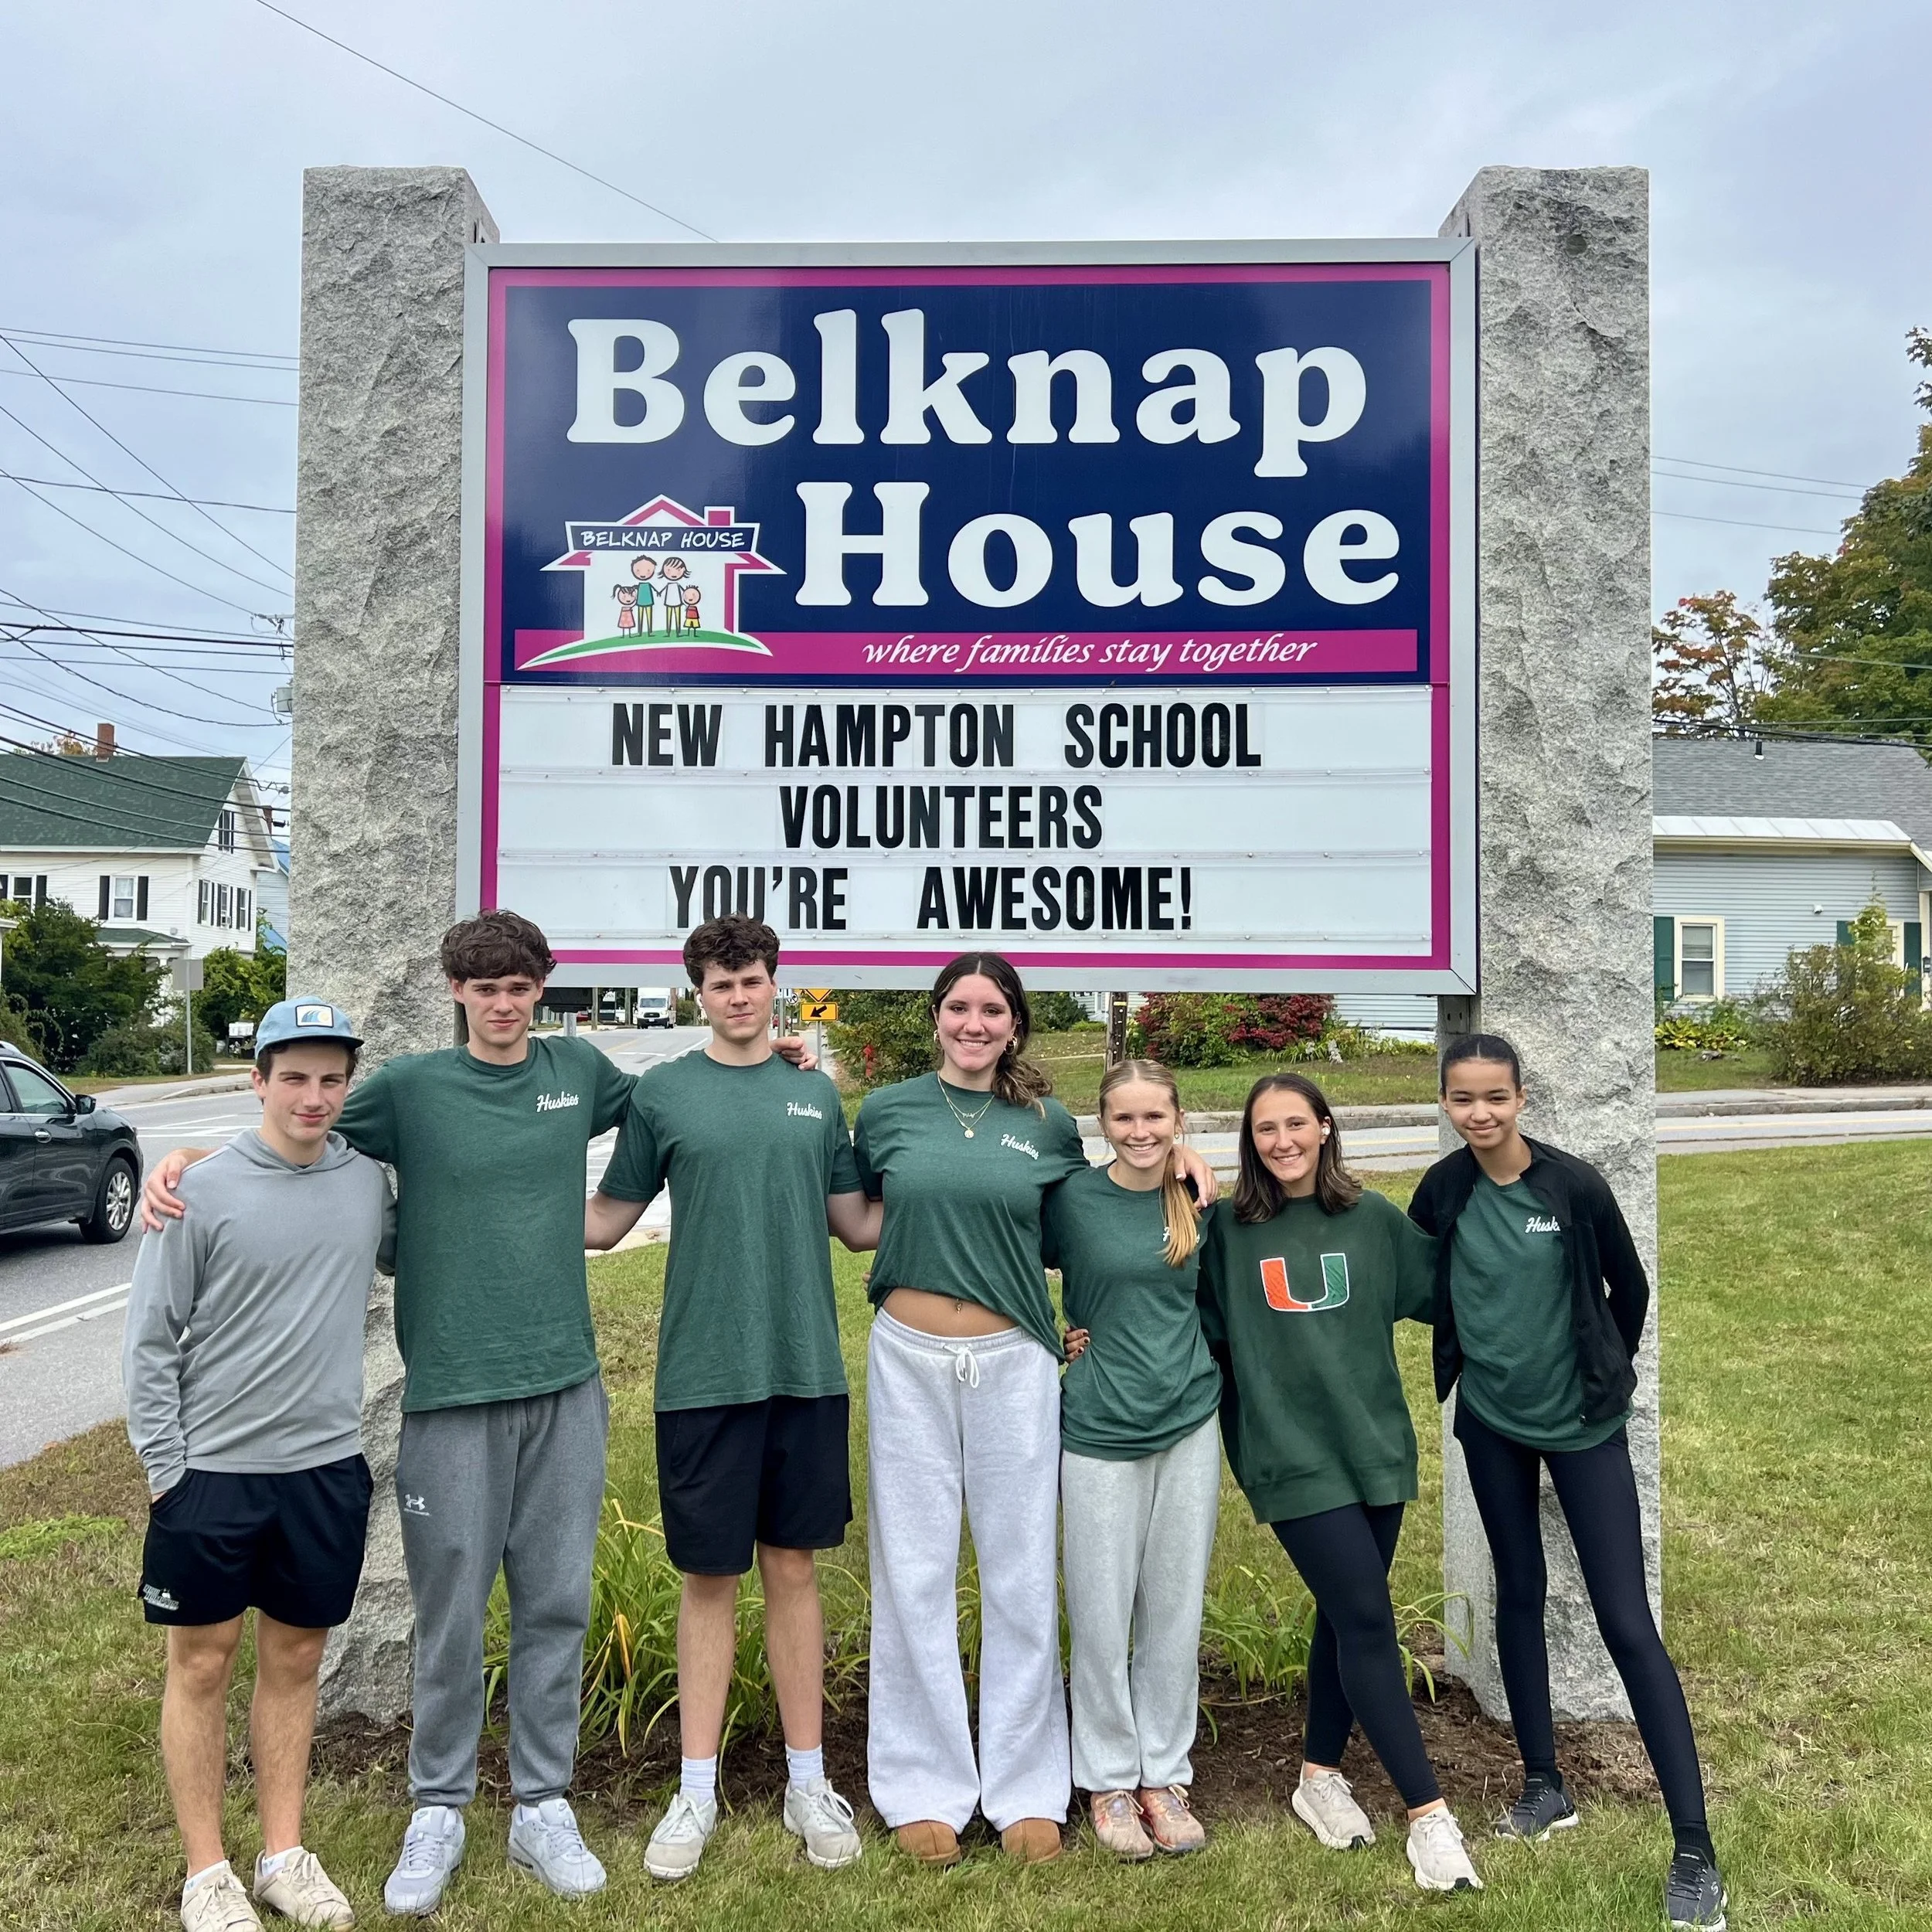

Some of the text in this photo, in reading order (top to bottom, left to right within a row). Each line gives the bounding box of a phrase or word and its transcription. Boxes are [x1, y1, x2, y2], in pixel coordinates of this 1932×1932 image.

[566, 308, 1366, 478] Belknap
[580, 530, 745, 549] BELKNAP HOUSE
[795, 481, 1400, 607] House
[862, 633, 1318, 672] where families stay together
[612, 702, 1261, 768] NEW HAMPTON SCHOOL
[779, 784, 1102, 849] VOLUNTEERS
[669, 866, 1192, 931] YOU'RE AWESOME!
[536, 1090, 580, 1113] Huskies
[787, 1101, 822, 1120] Huskies
[1000, 1133, 1039, 1160] Huskies
[1259, 1252, 1350, 1312] U
